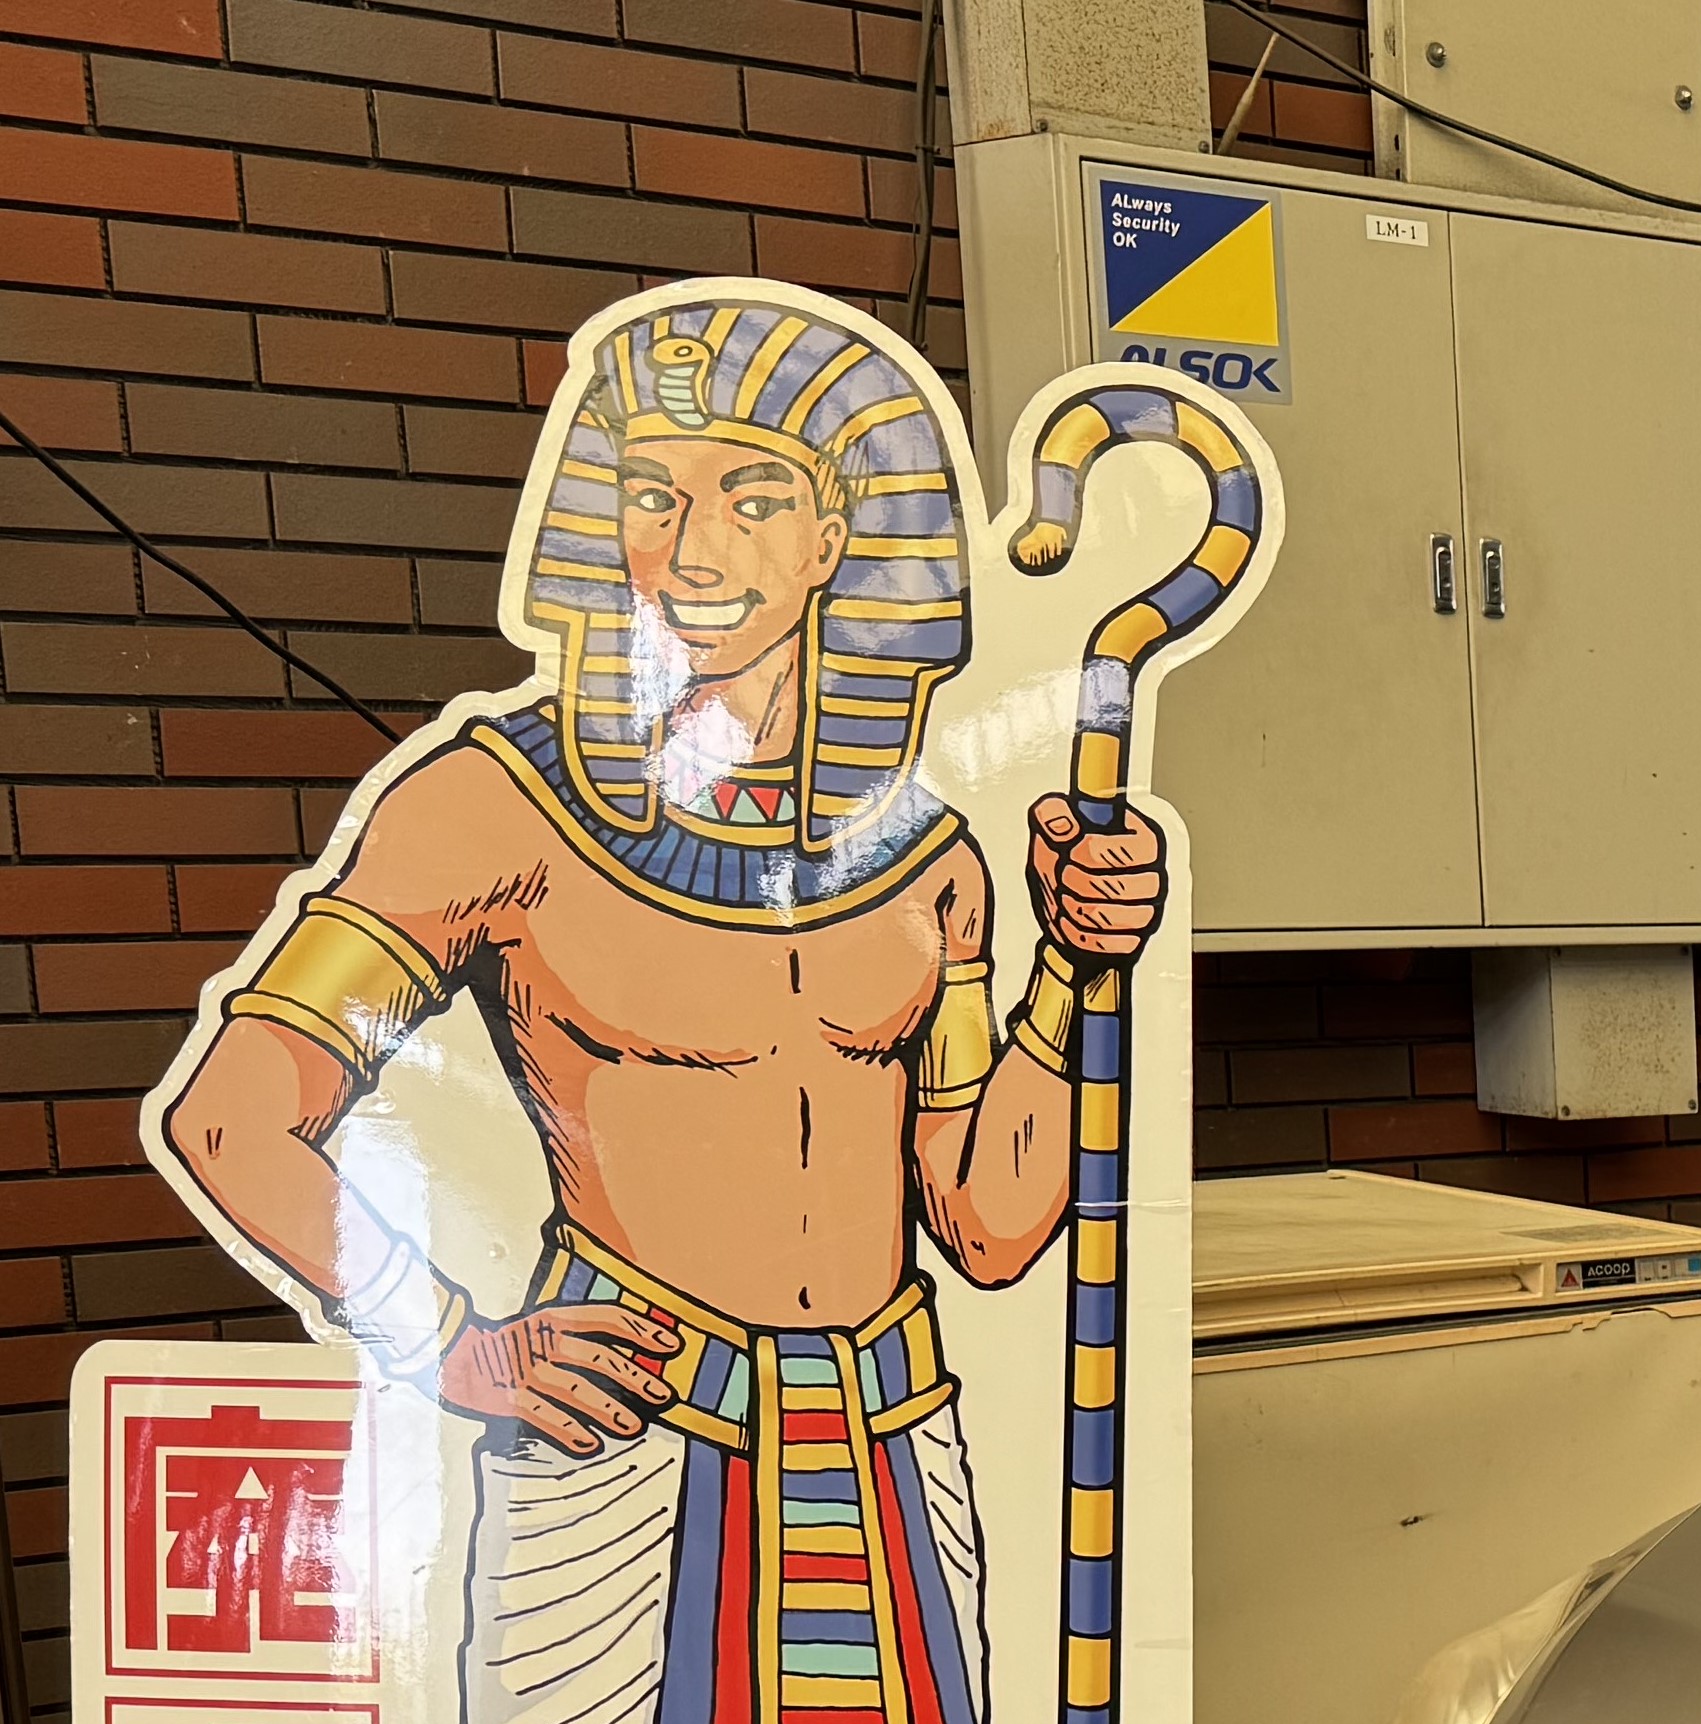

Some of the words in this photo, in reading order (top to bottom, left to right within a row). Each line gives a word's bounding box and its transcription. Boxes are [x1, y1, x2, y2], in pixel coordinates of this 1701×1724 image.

[1111, 193, 1172, 216] ALways
[1112, 212, 1181, 237] Security
[1375, 220, 1416, 240] LM-1
[1113, 231, 1138, 249] OK
